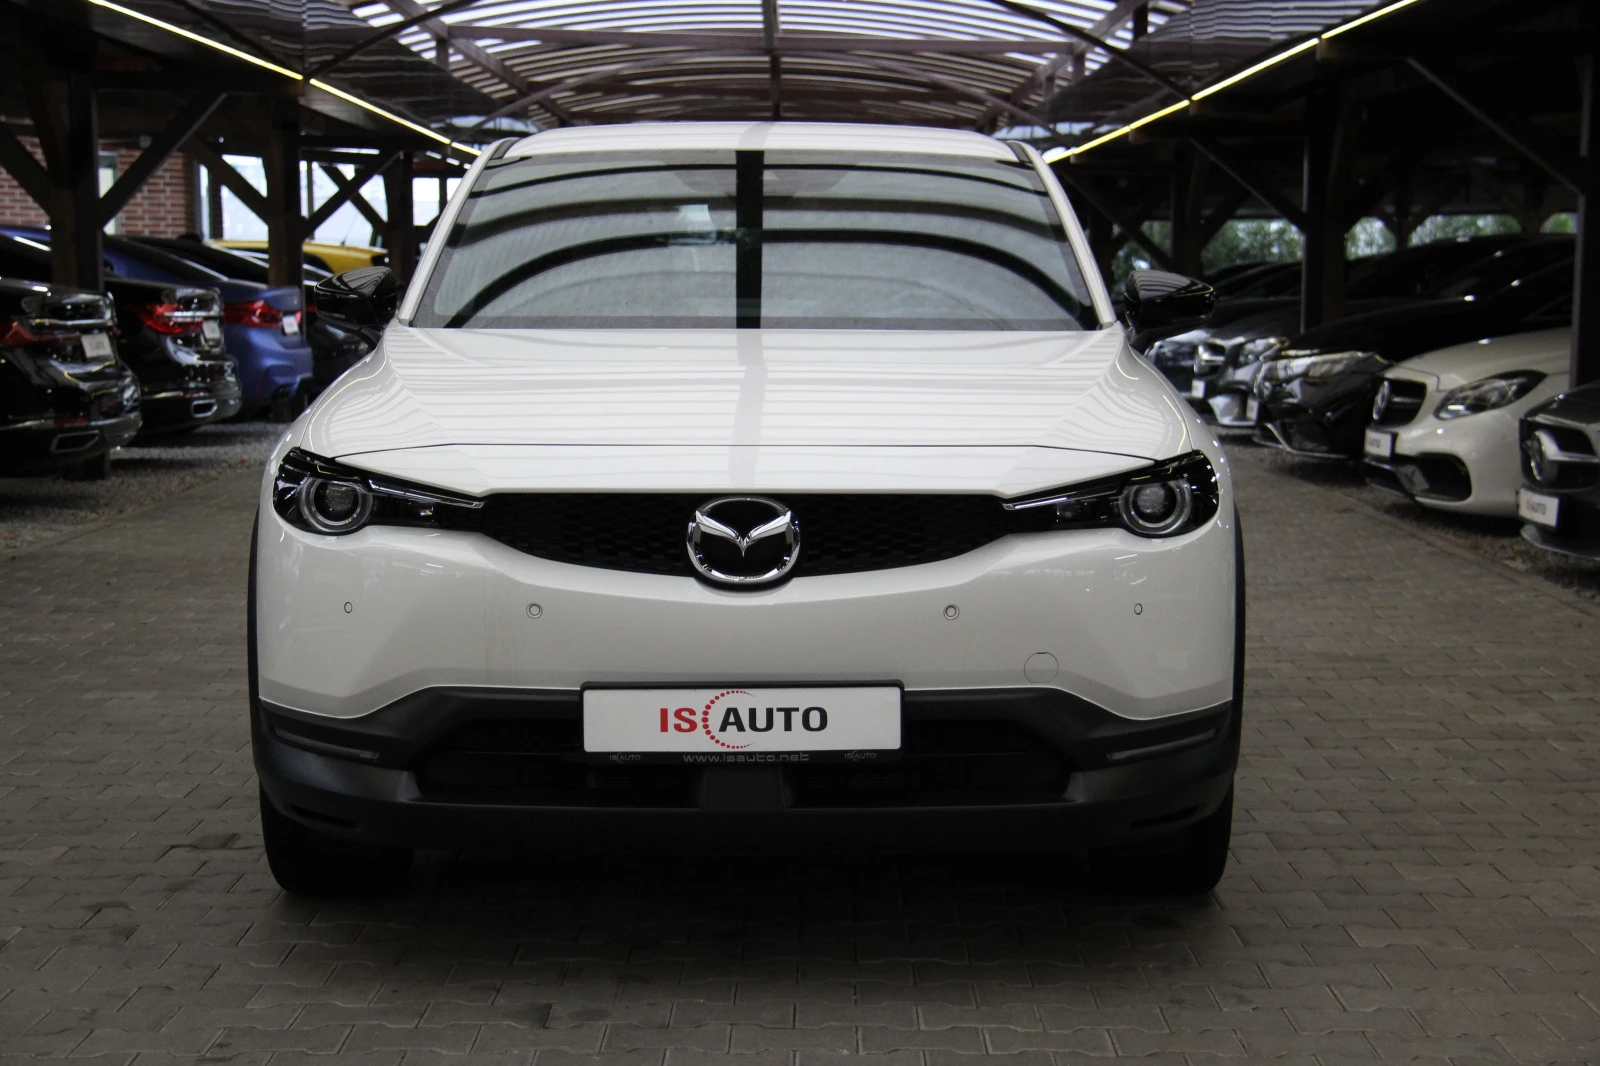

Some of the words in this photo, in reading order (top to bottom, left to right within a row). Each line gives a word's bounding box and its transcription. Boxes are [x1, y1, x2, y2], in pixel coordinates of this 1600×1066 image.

[660, 707, 698, 732] IS
[718, 706, 829, 732] AUTO
[682, 752, 810, 762] www.isauto.net
